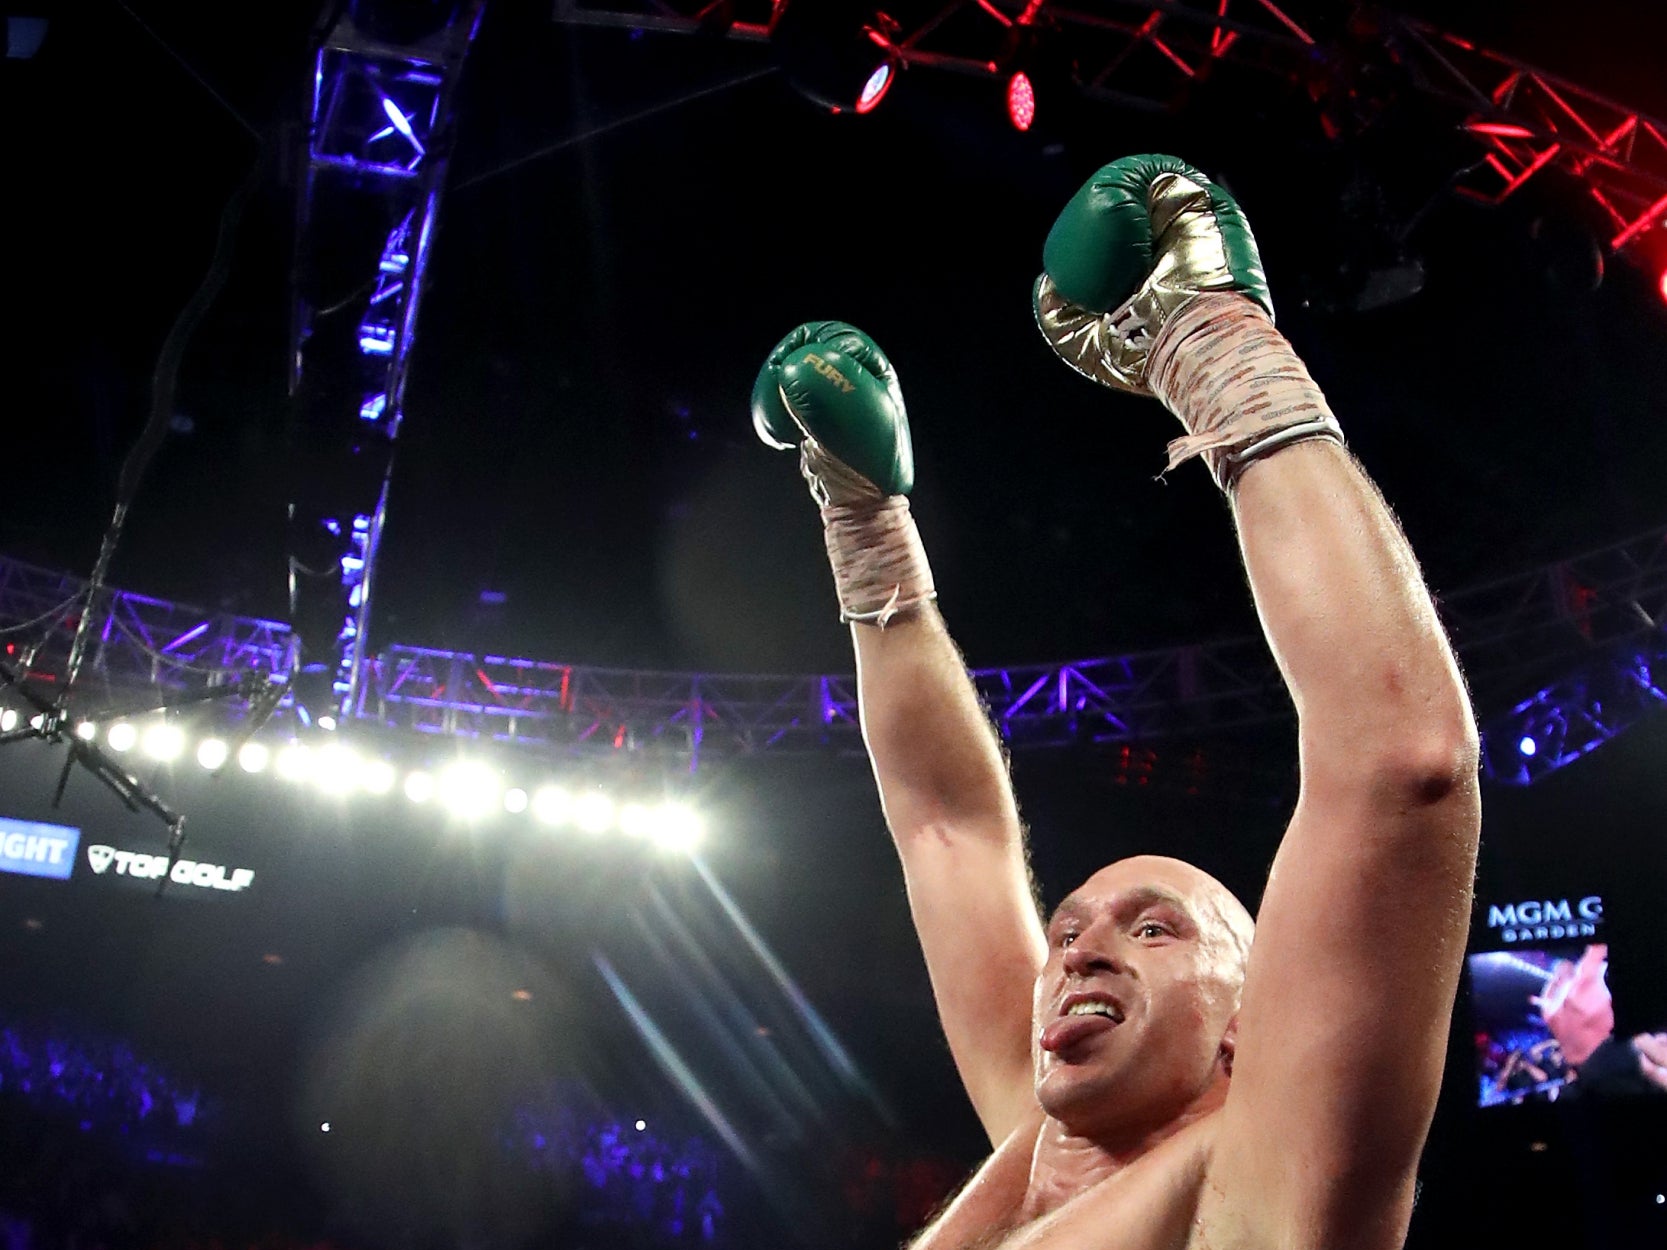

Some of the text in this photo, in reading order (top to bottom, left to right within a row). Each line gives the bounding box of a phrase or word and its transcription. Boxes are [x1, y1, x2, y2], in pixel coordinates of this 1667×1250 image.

[803, 353, 856, 393] FURY
[1488, 900, 1572, 929] MGM
[1501, 922, 1596, 943] GARDEN
